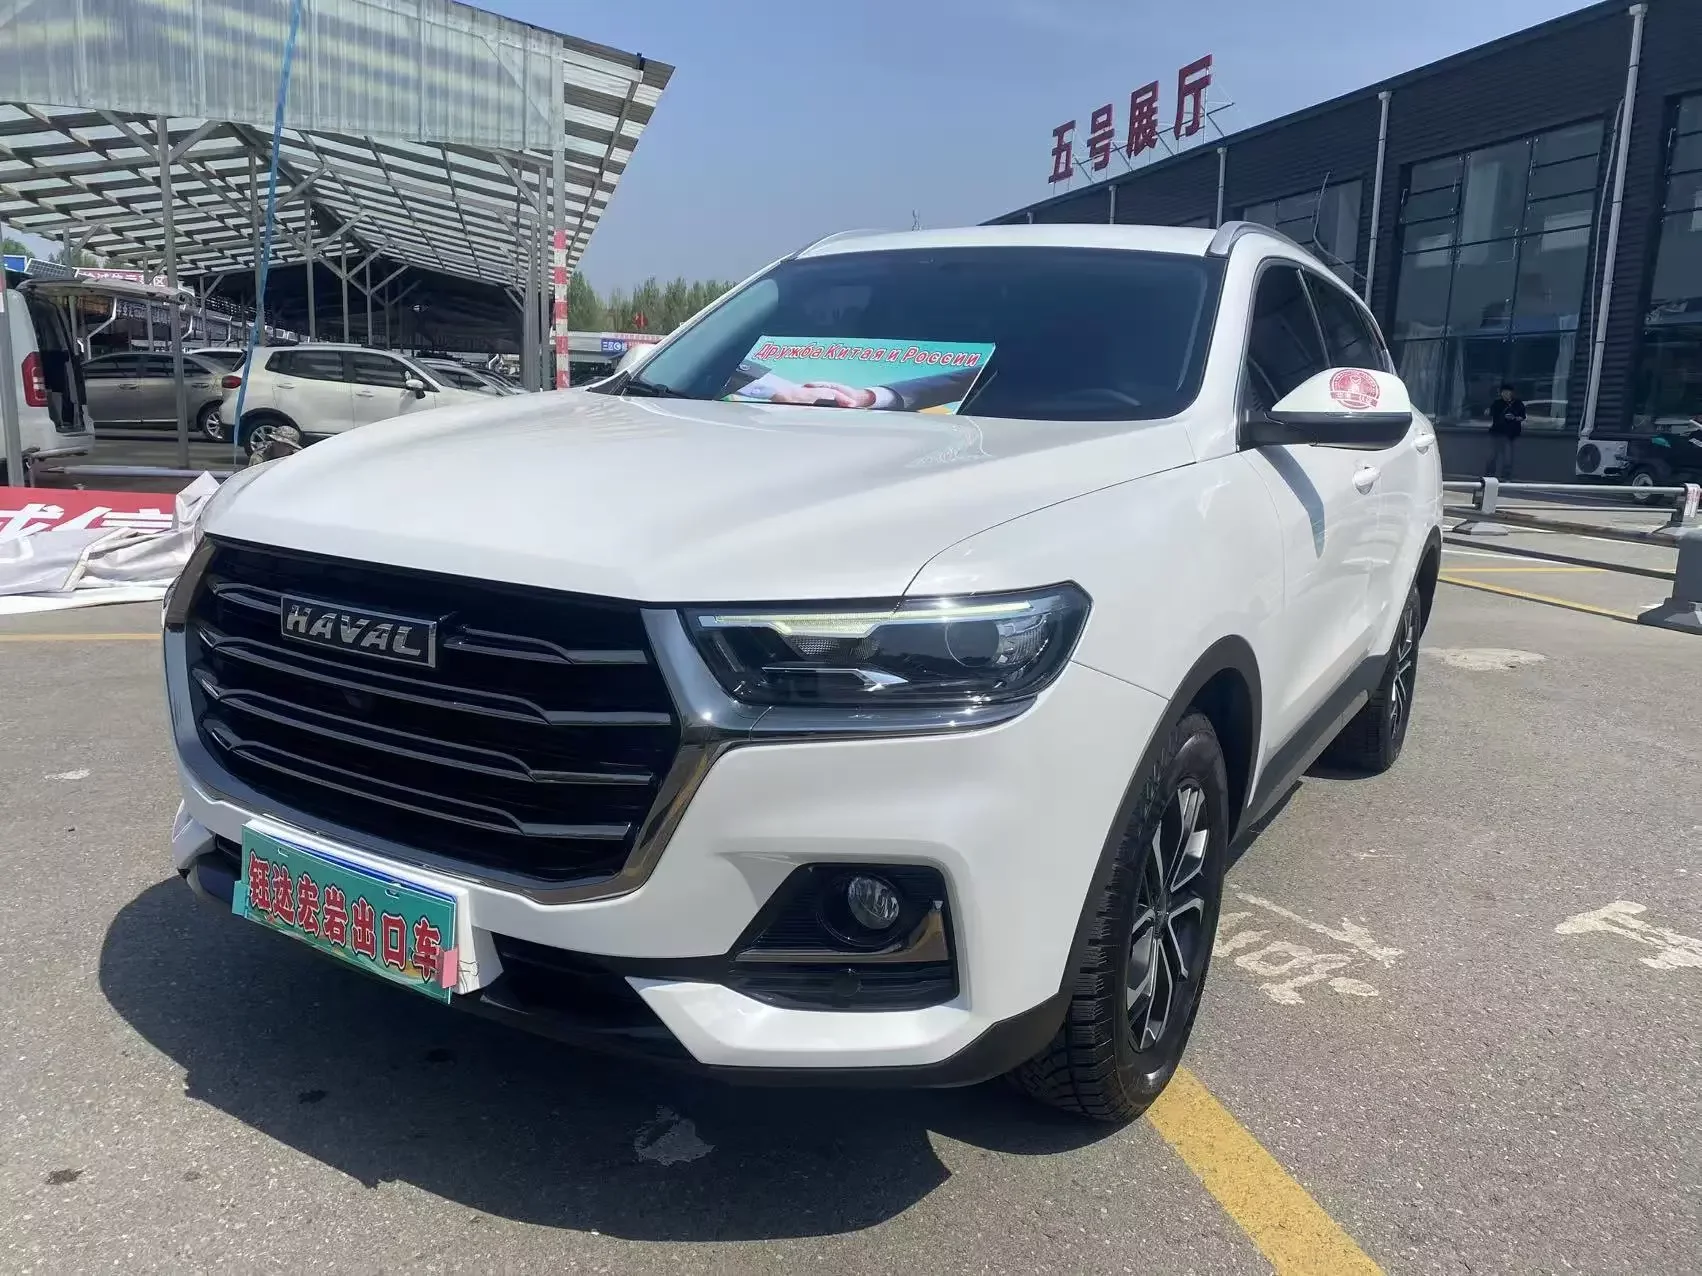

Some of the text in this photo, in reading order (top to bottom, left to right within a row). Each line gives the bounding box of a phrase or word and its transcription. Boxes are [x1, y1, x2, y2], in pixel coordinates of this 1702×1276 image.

[1048, 53, 1212, 184] 五号展厅
[754, 341, 981, 366] Дружба Китая и России
[286, 604, 421, 657] HAVAL
